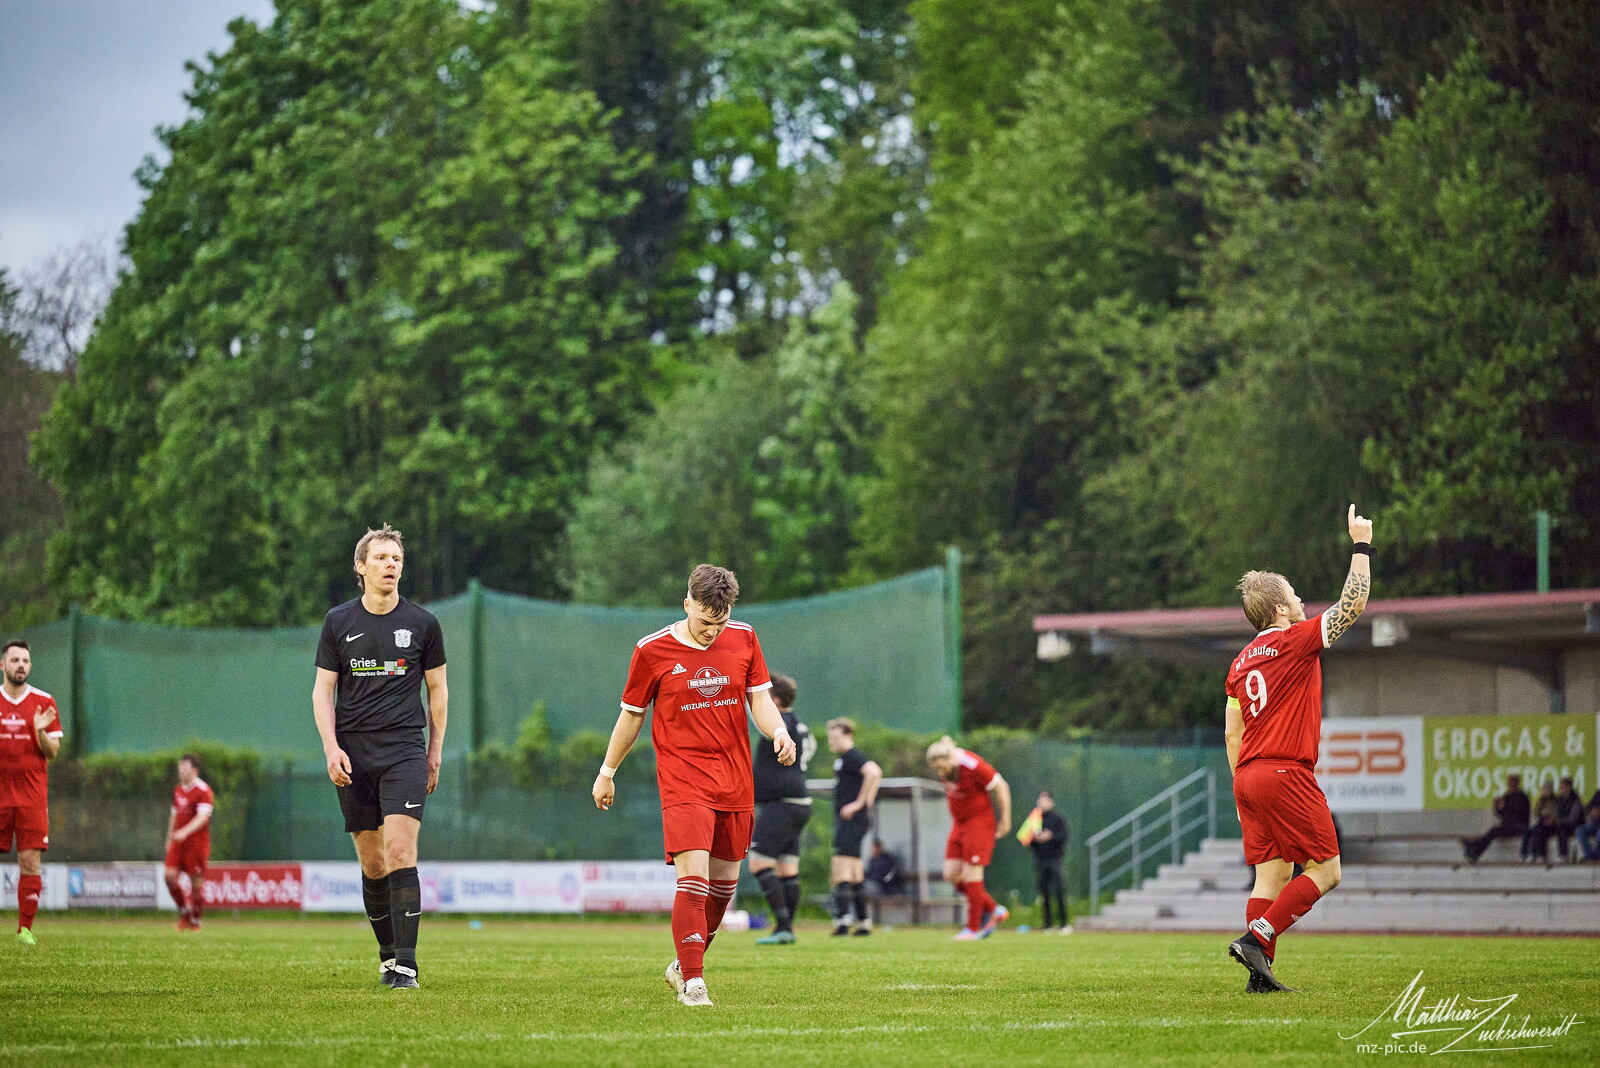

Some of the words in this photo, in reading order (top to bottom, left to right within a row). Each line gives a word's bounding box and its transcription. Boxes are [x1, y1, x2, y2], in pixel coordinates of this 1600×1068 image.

[350, 657, 377, 668] Gries
[1248, 644, 1279, 659] Laufen
[681, 701, 710, 711] HEIZUNG
[713, 697, 738, 707] SANITÄR
[1245, 669, 1268, 717] 9
[1315, 731, 1406, 775] SB
[1432, 726, 1552, 760] ERDGAS
[1565, 725, 1584, 757] &
